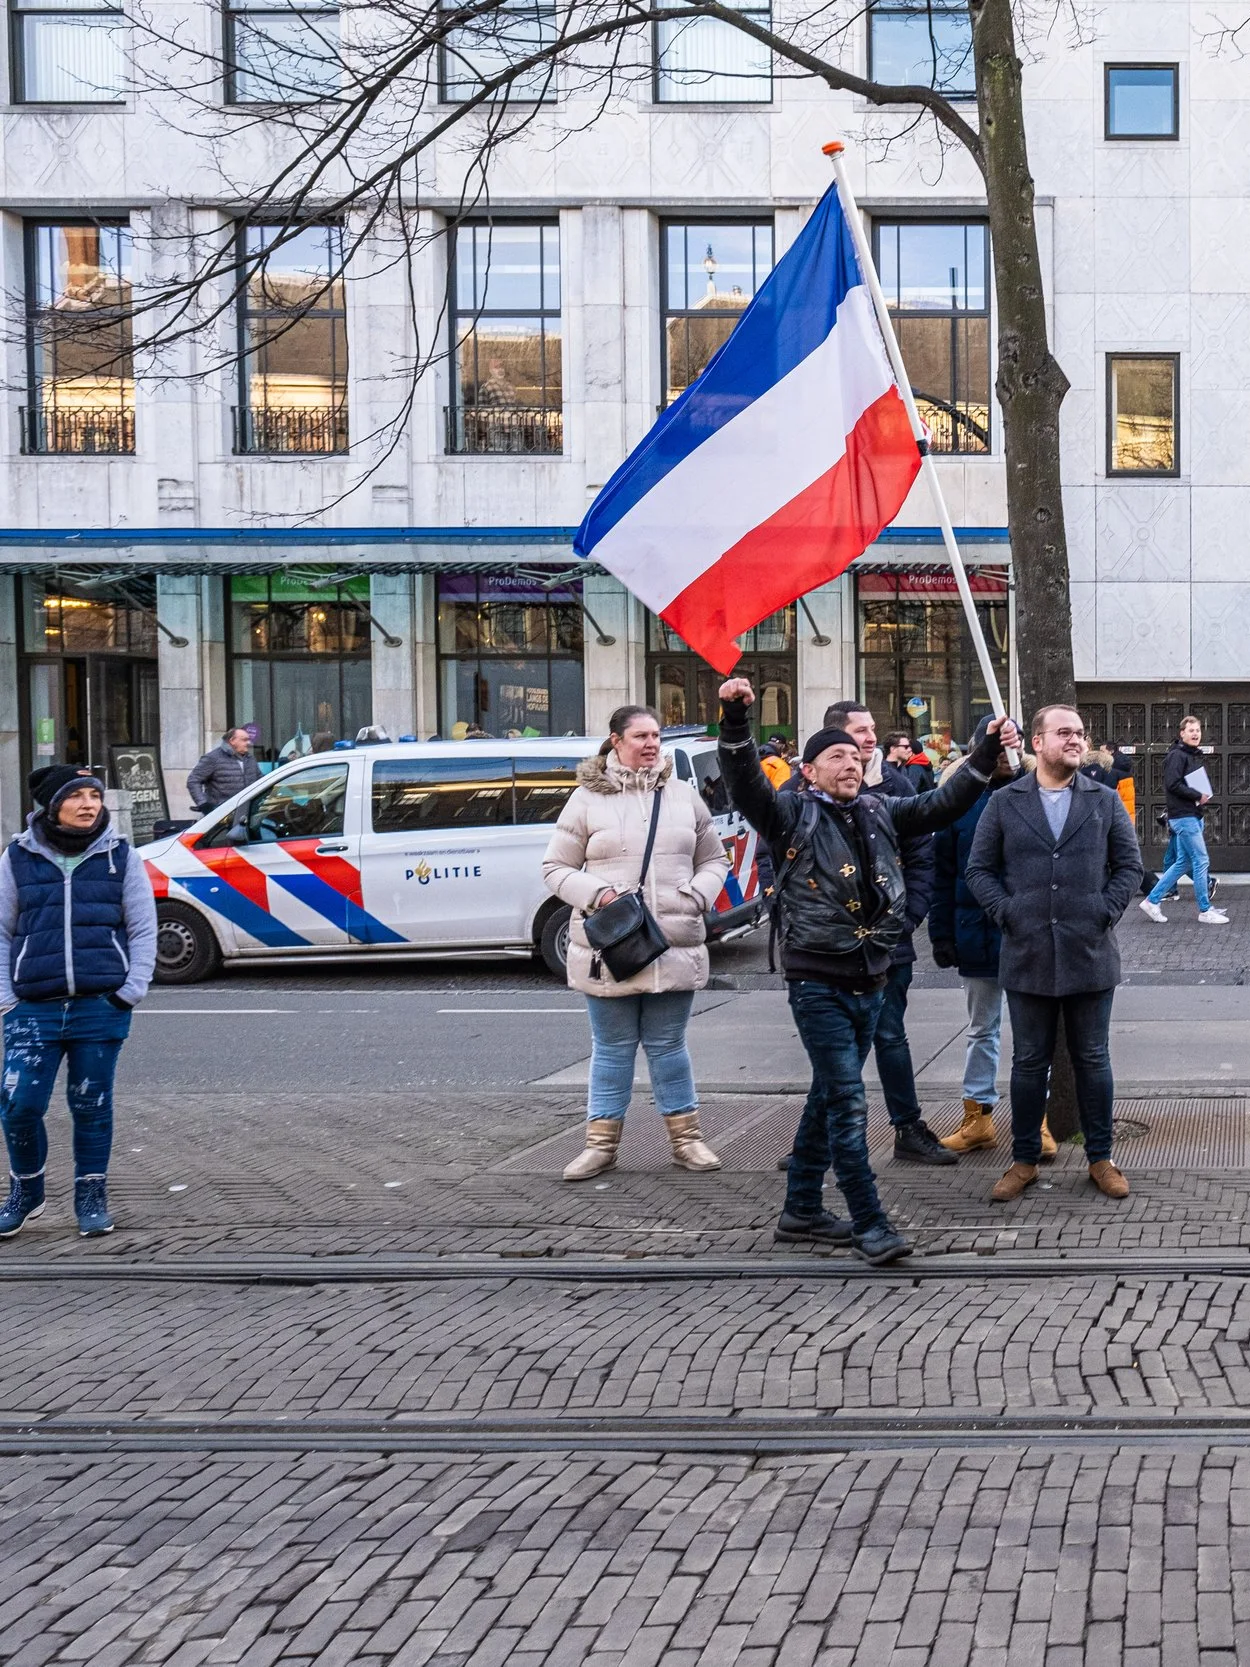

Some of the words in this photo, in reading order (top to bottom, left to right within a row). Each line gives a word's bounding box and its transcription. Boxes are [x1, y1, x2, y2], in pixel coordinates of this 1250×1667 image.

[488, 577, 537, 586] ProDemos
[908, 575, 957, 585] ProDemos
[131, 789, 160, 803] EGEN!
[405, 866, 482, 885] POLITIE
